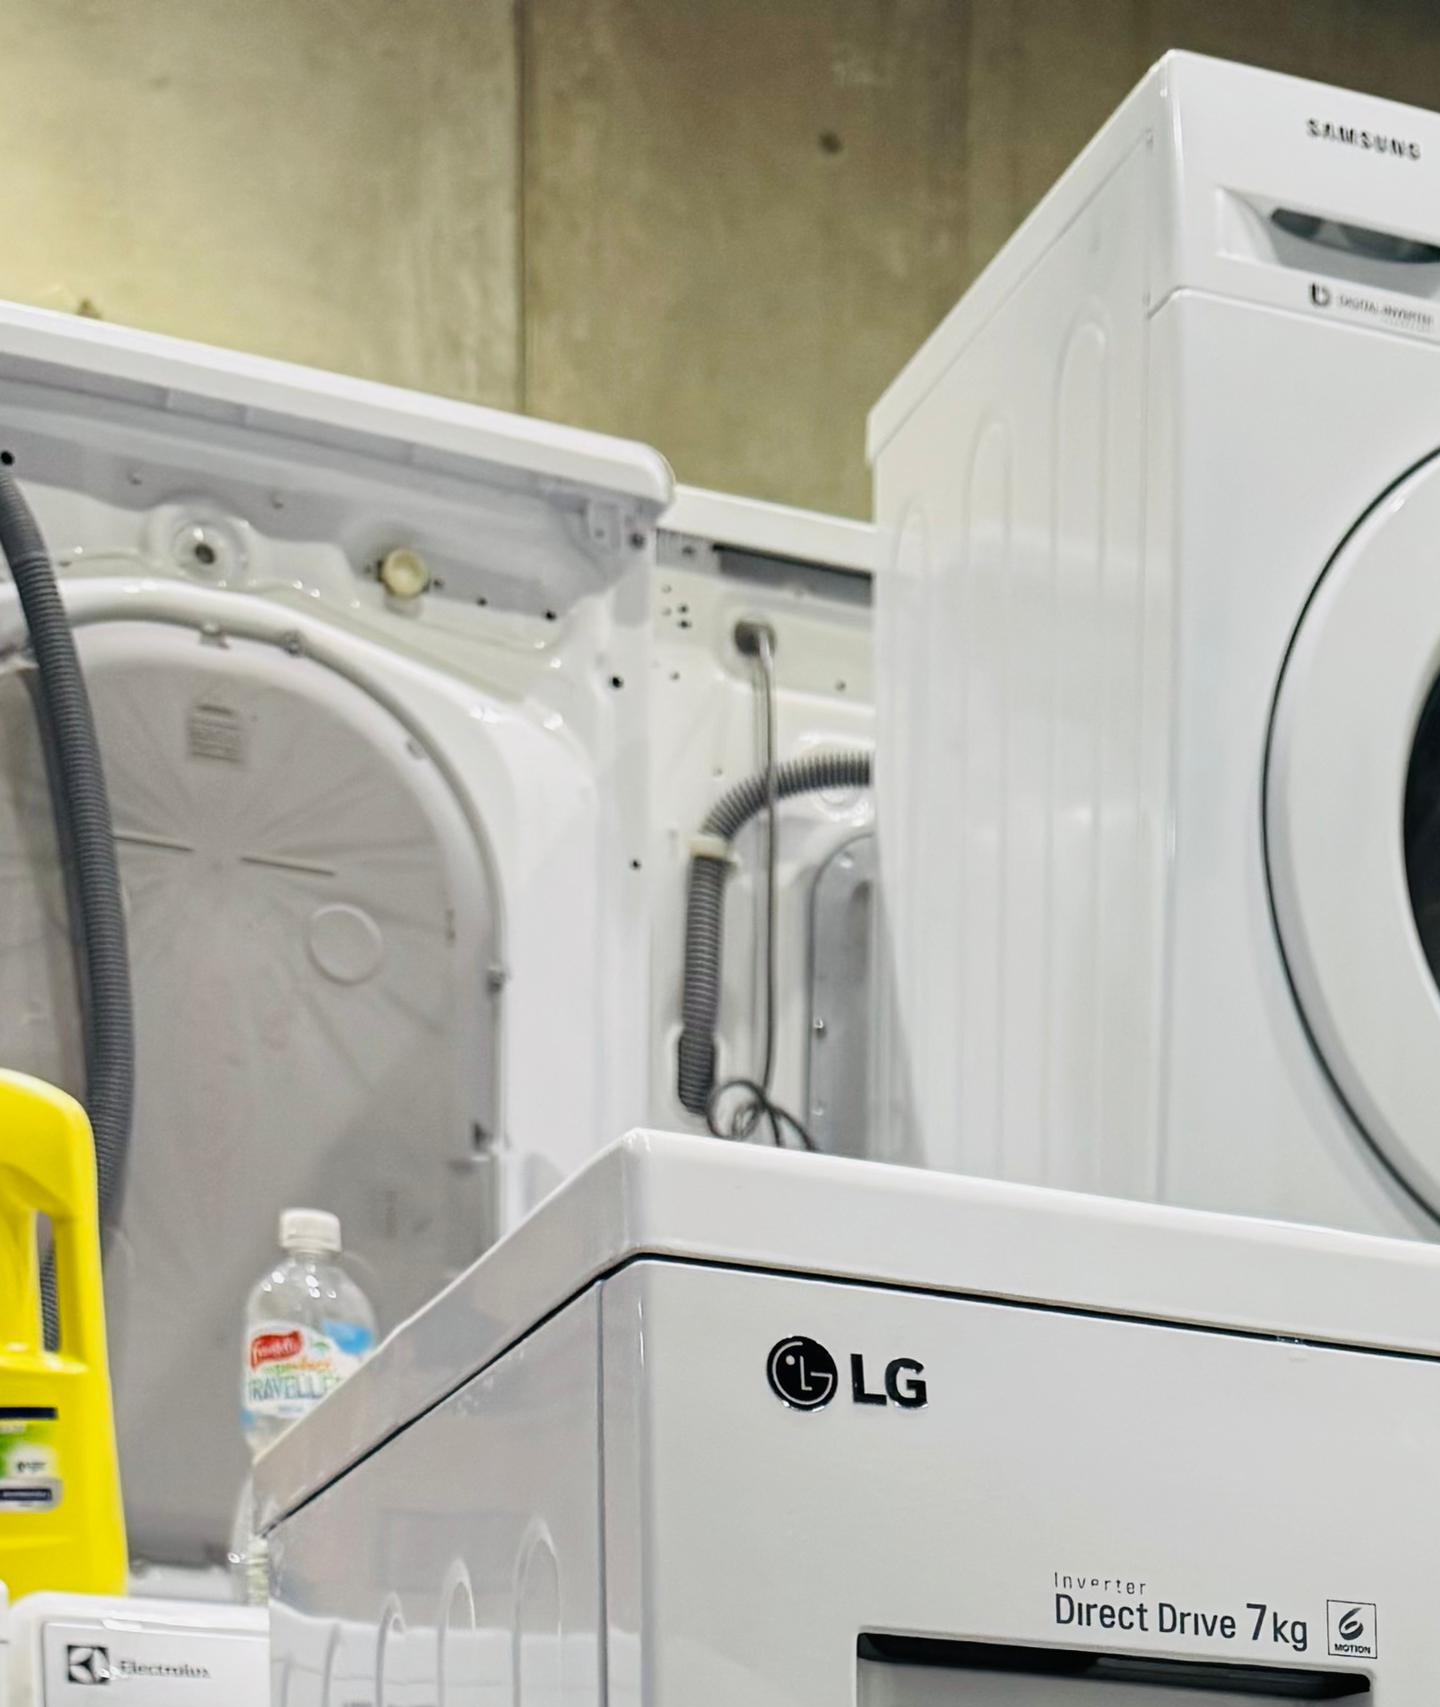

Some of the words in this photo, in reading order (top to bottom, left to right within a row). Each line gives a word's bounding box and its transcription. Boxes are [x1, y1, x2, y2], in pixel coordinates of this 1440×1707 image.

[1306, 118, 1421, 160] SAMSUNG
[850, 1353, 928, 1409] LG
[1054, 1571, 1147, 1596] Inverter
[1055, 1593, 1149, 1632] Direct
[1158, 1602, 1236, 1638] Drive
[1334, 1643, 1371, 1654] MOTION
[120, 1659, 211, 1679] Electrolux
